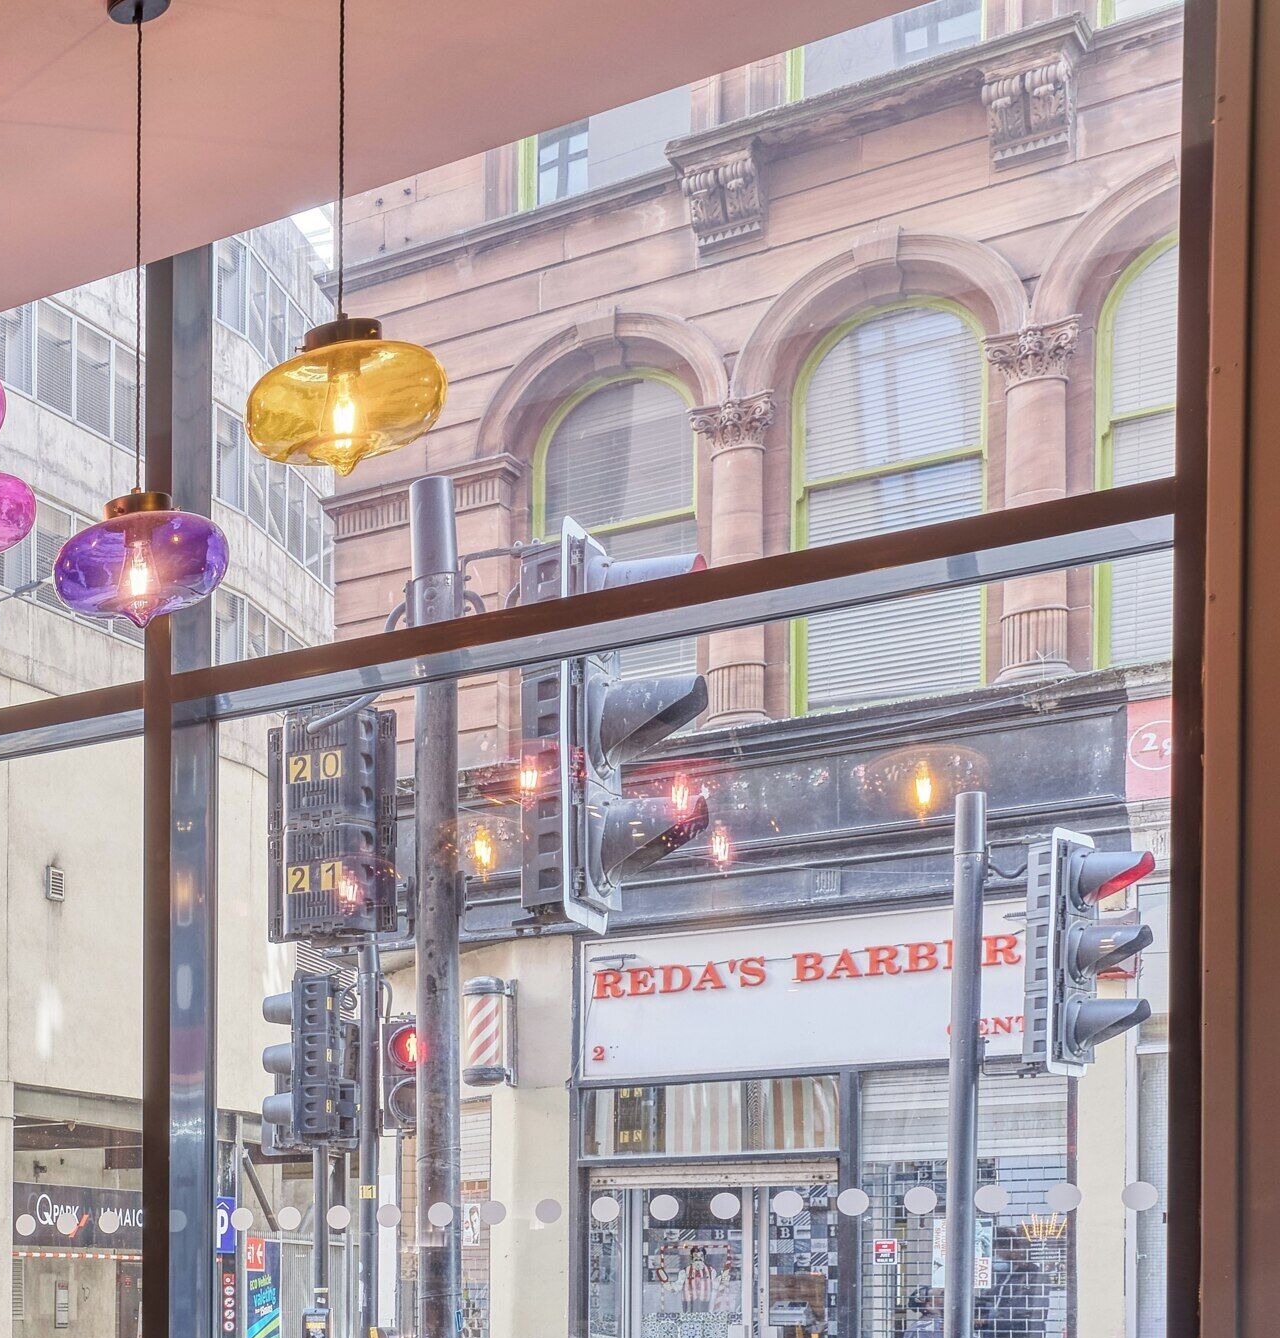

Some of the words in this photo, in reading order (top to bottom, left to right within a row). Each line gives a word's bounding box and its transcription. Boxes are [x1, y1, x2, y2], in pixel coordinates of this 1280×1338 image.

[592, 955, 765, 999] REDA'S
[792, 935, 1021, 982] BARBR
[947, 1015, 1025, 1036] ENT
[592, 1046, 604, 1061] 2
[101, 1207, 143, 1227] MAIC
[978, 1258, 989, 1286] FACE
